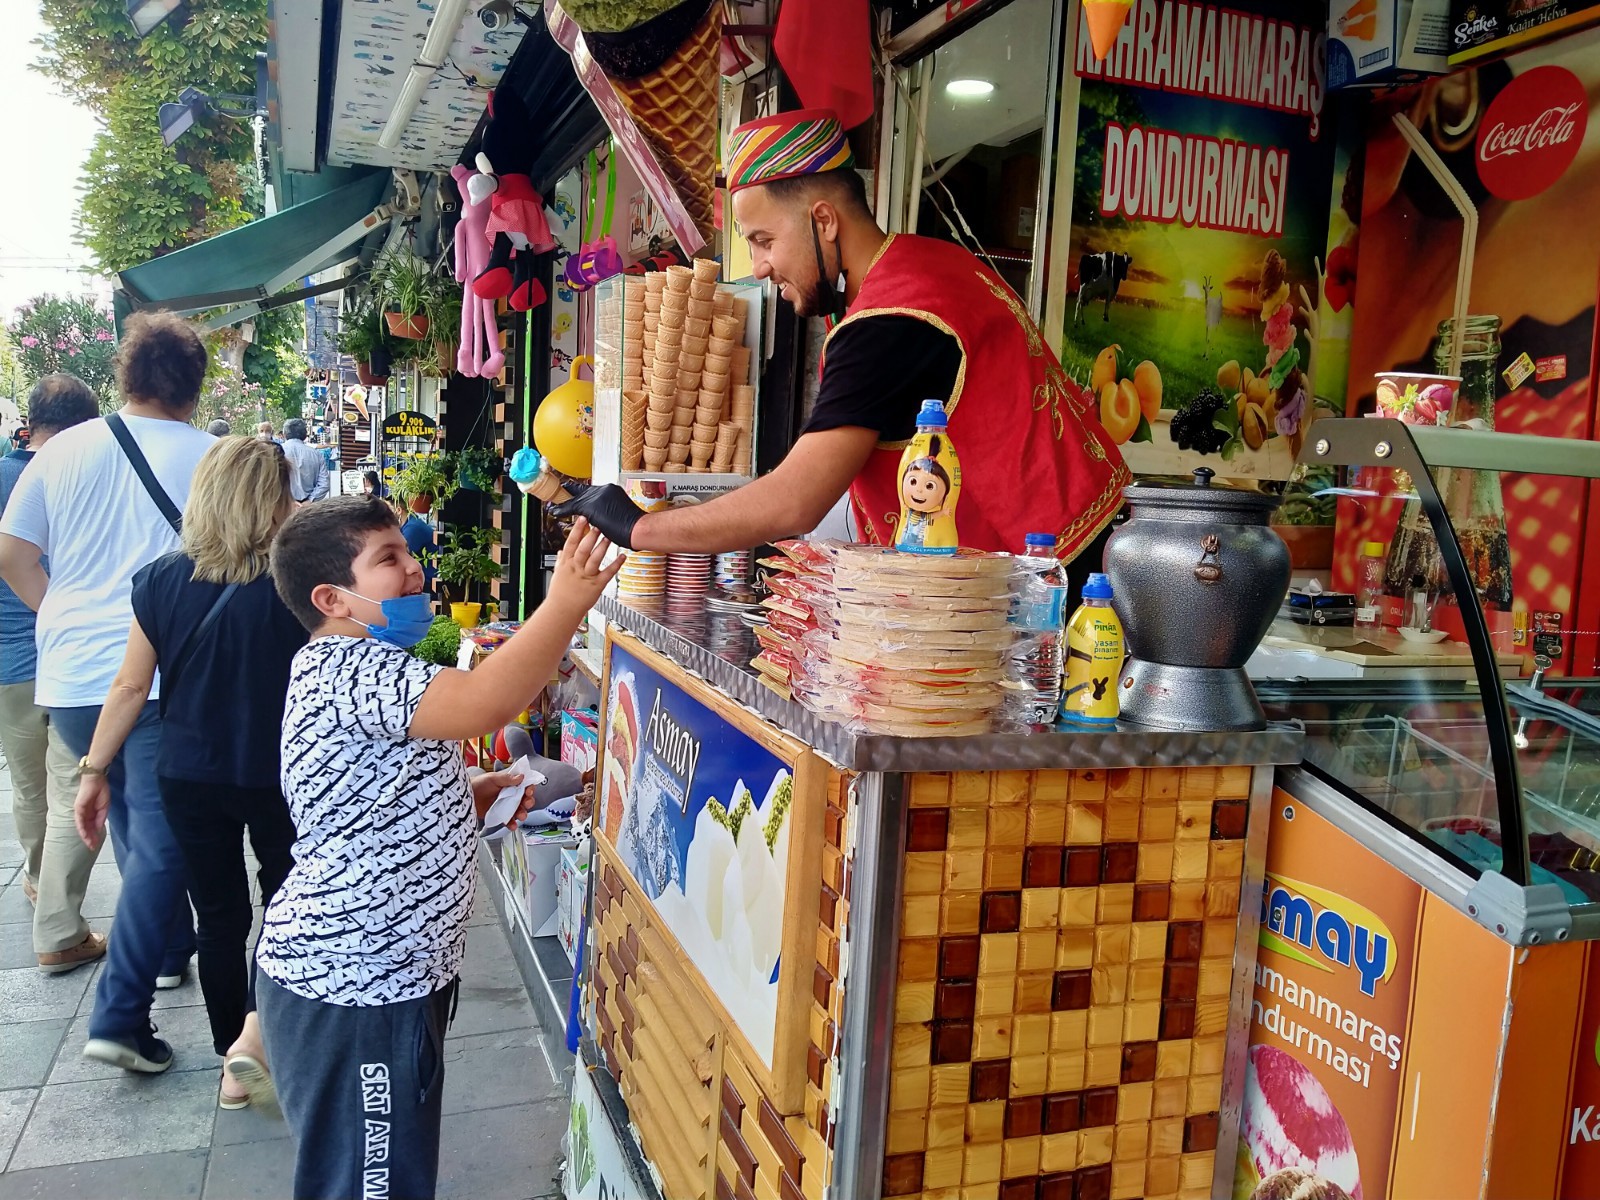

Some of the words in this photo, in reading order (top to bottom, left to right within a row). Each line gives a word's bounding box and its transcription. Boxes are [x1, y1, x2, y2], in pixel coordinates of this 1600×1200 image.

[1537, 5, 1567, 24] Helva
[1480, 100, 1584, 162] Coca-Cola
[1101, 124, 1290, 235] DONDURMASI
[385, 425, 435, 436] KULAKLIK
[644, 687, 701, 814] Asmay
[360, 1062, 391, 1115] SRT
[364, 1118, 391, 1168] AIR
